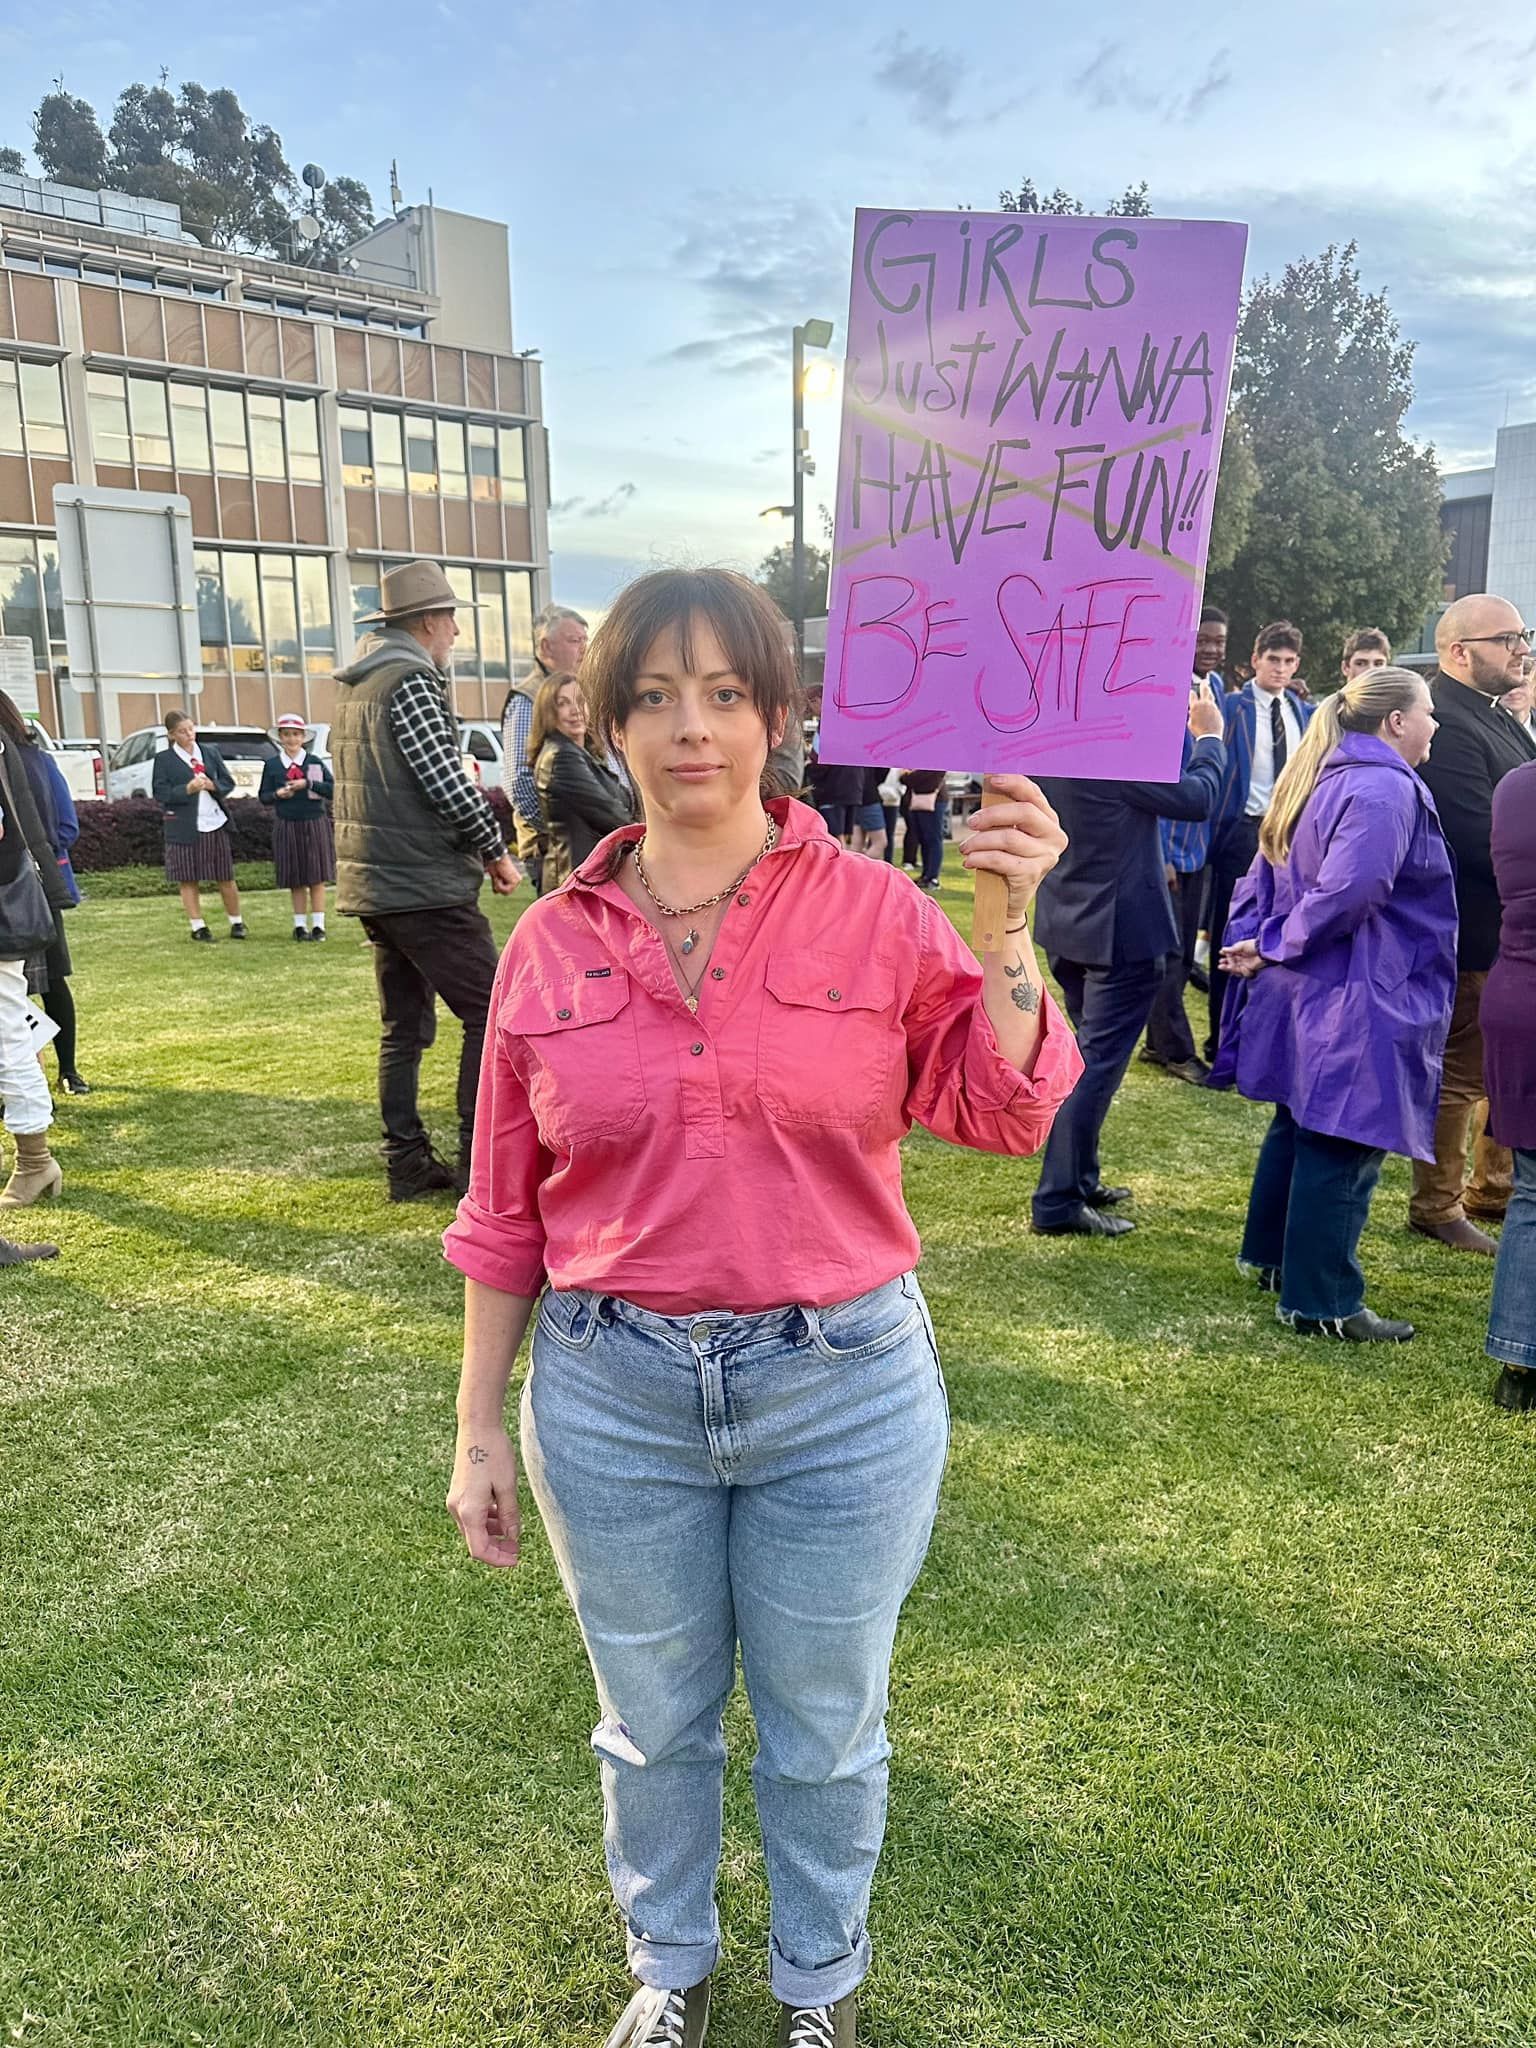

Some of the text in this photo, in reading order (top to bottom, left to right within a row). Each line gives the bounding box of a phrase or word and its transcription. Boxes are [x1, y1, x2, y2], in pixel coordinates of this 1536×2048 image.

[988, 328, 1214, 434] WANNA
[852, 432, 1212, 564] HAVE FUN!!
[833, 573, 968, 721] BE
